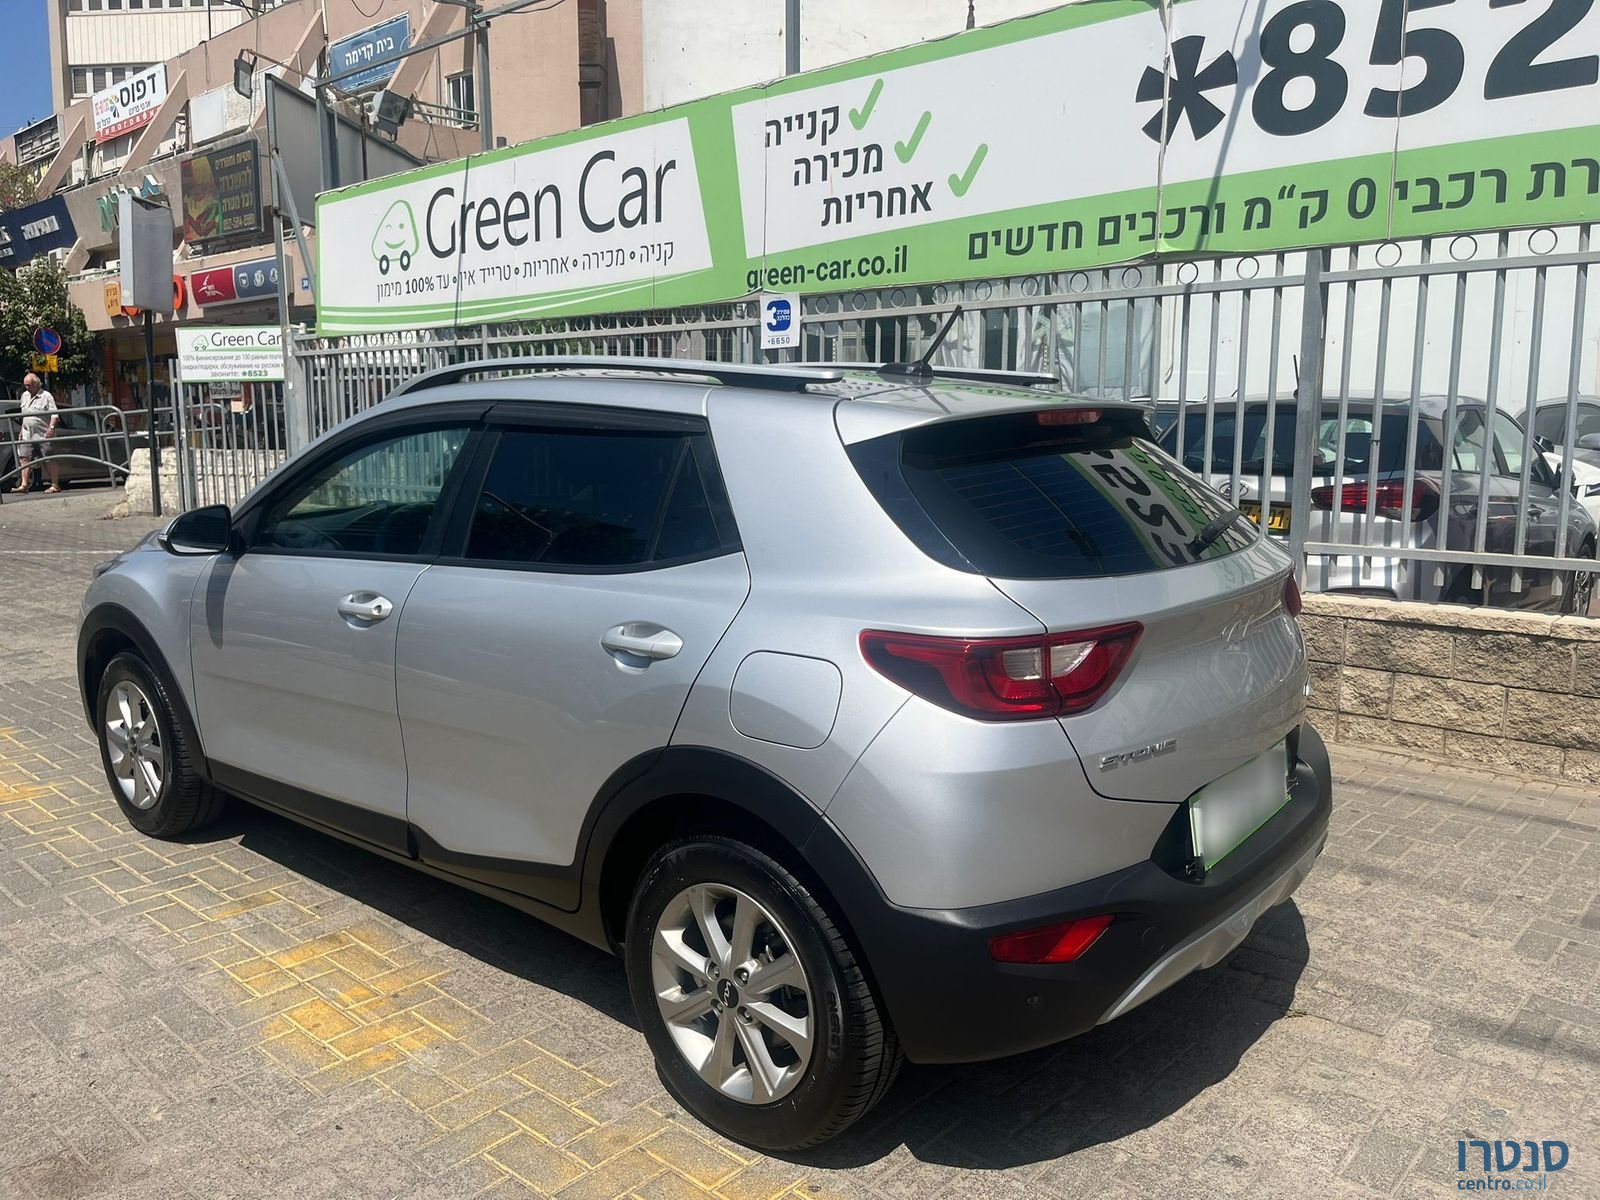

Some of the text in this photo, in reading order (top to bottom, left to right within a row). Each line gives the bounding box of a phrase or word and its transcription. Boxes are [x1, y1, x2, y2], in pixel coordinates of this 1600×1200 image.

[344, 36, 395, 66] בית קדימה
[119, 73, 156, 107] דפוס
[764, 105, 840, 148] קנייה
[794, 143, 883, 187] מכירה
[426, 150, 676, 259] Green Car
[821, 181, 934, 228] אחריות
[1347, 177, 1377, 219] 0
[1394, 168, 1507, 214] רכבי
[968, 220, 1083, 260] חדשים
[1098, 202, 1226, 246] ורכבים
[377, 241, 674, 303] קניה מכירה אחריות טרייד אין עד 100% מימון
[747, 245, 908, 293] green-car.co.il
[211, 331, 283, 347] Green Car
[1099, 738, 1177, 772] STONIC
